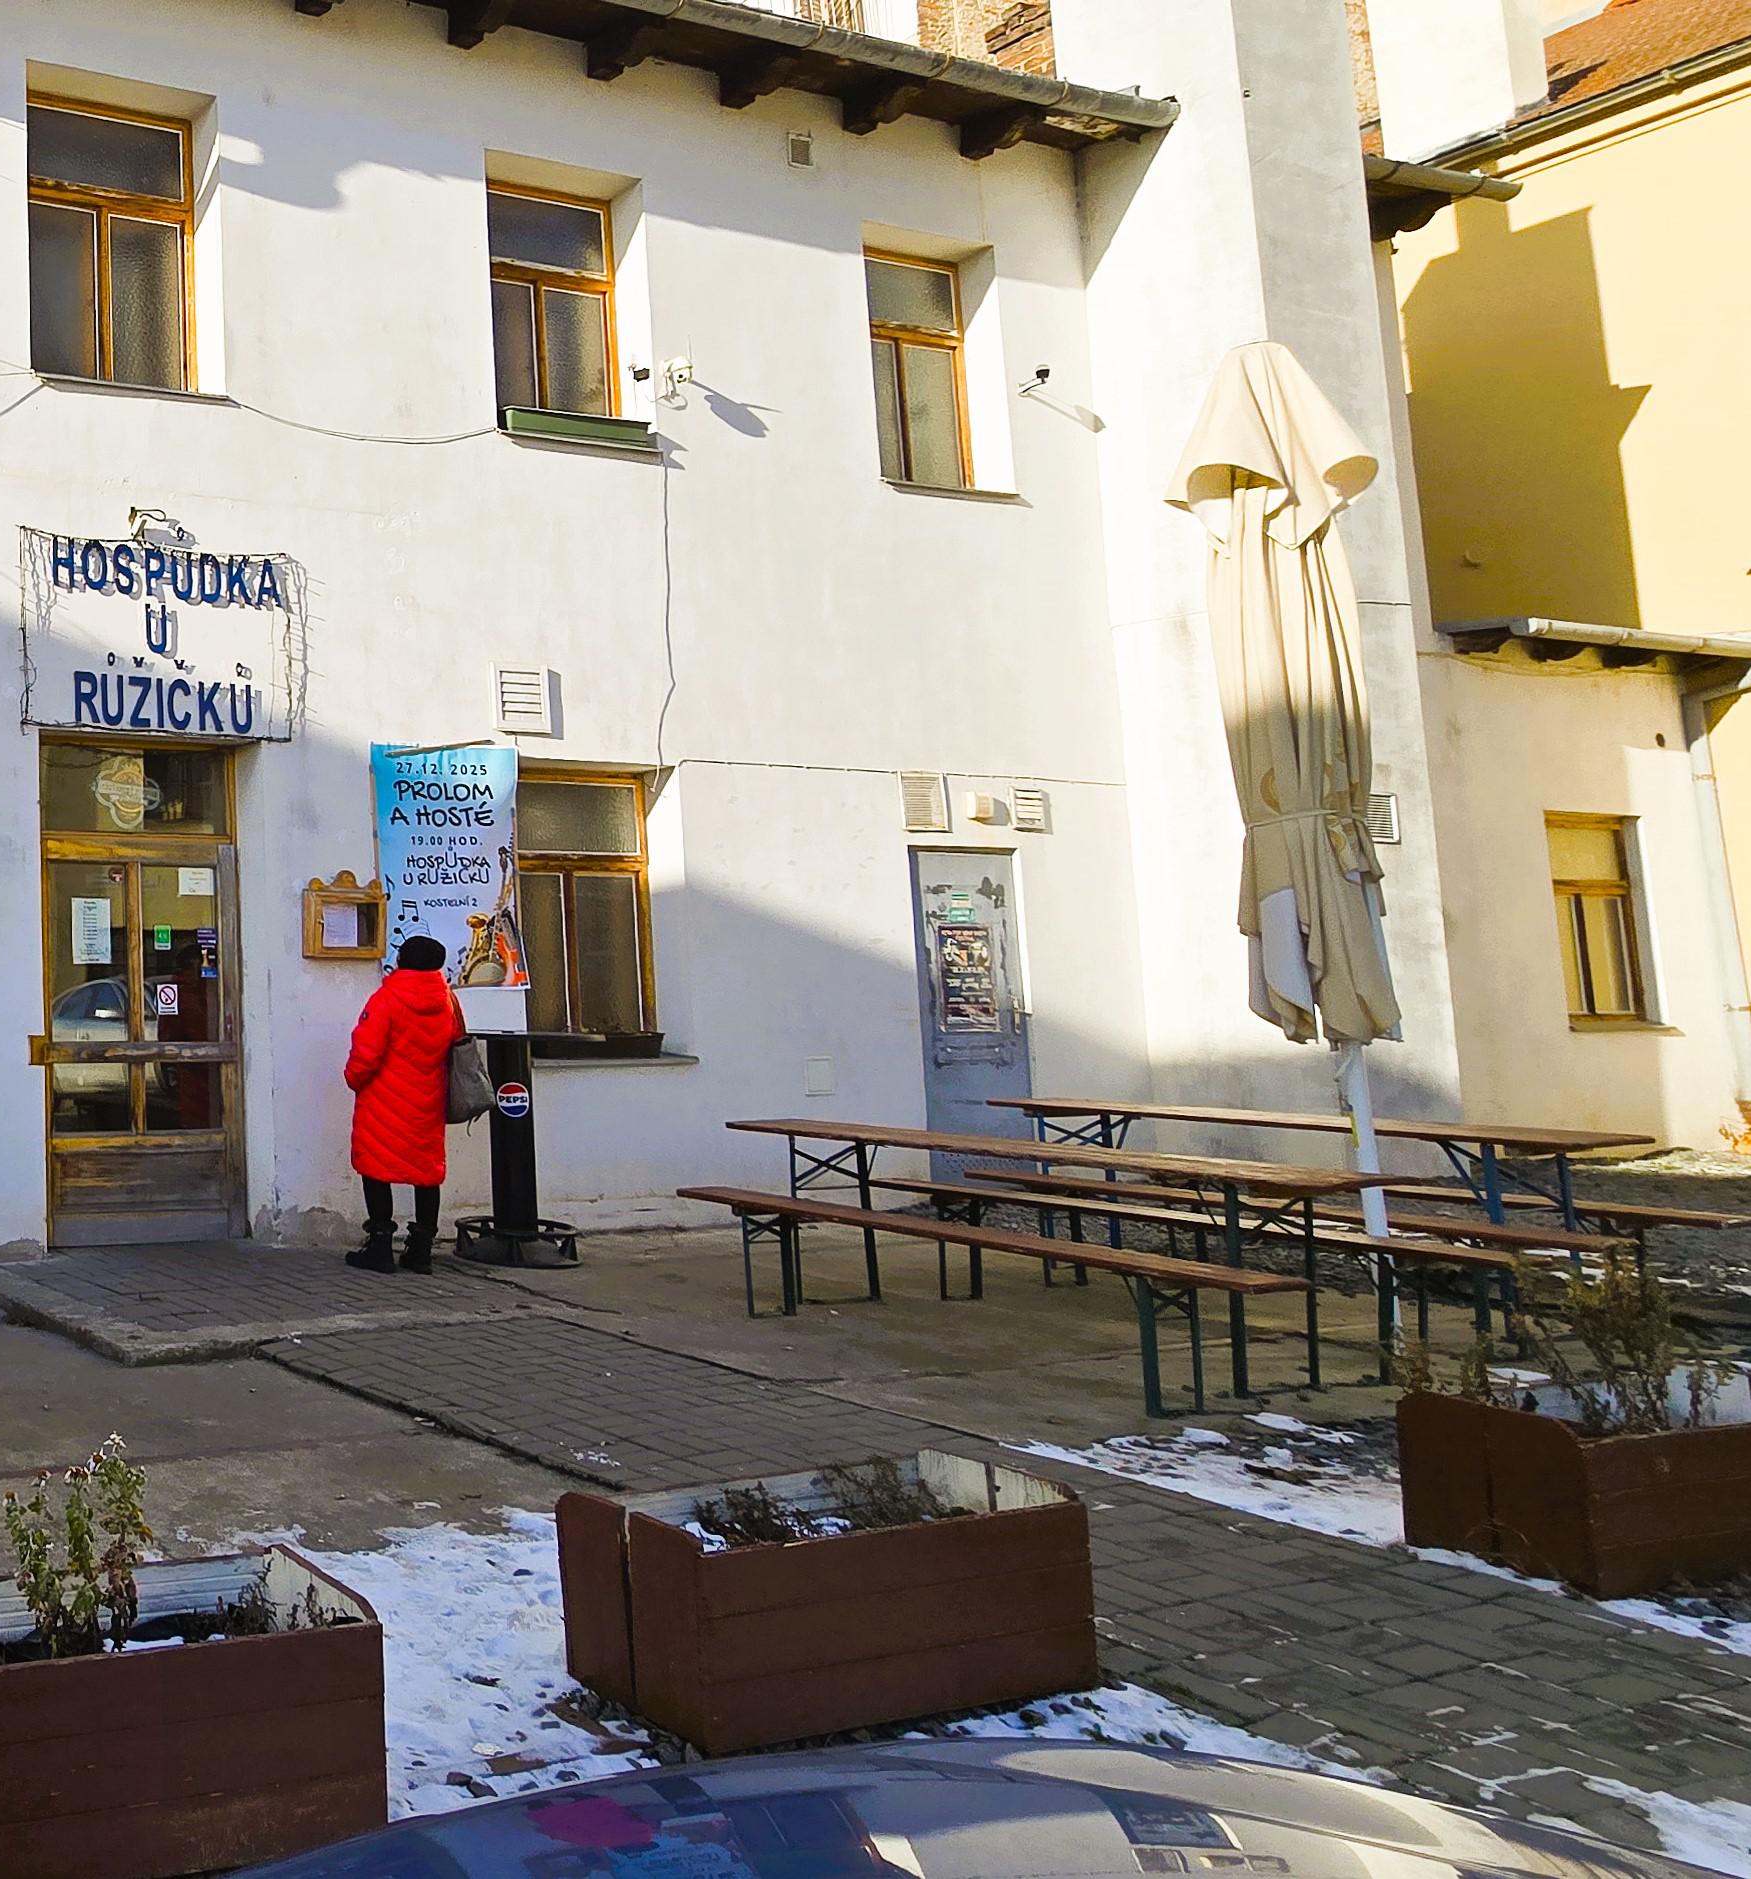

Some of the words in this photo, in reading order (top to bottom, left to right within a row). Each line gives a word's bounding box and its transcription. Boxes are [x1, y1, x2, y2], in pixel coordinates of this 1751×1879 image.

[145, 603, 167, 653] U
[74, 652, 253, 734] RŮŽIČKŮ
[396, 762, 443, 775] 27.12.
[451, 764, 487, 775] 2025
[393, 780, 494, 801] PROLOM
[390, 806, 410, 826] A
[415, 801, 494, 827] HOSTÉ
[411, 836, 443, 846] 19.00
[449, 836, 483, 846] HOD.
[403, 872, 413, 886] U
[471, 897, 478, 907] 2
[498, 1094, 528, 1104] PEPSI
